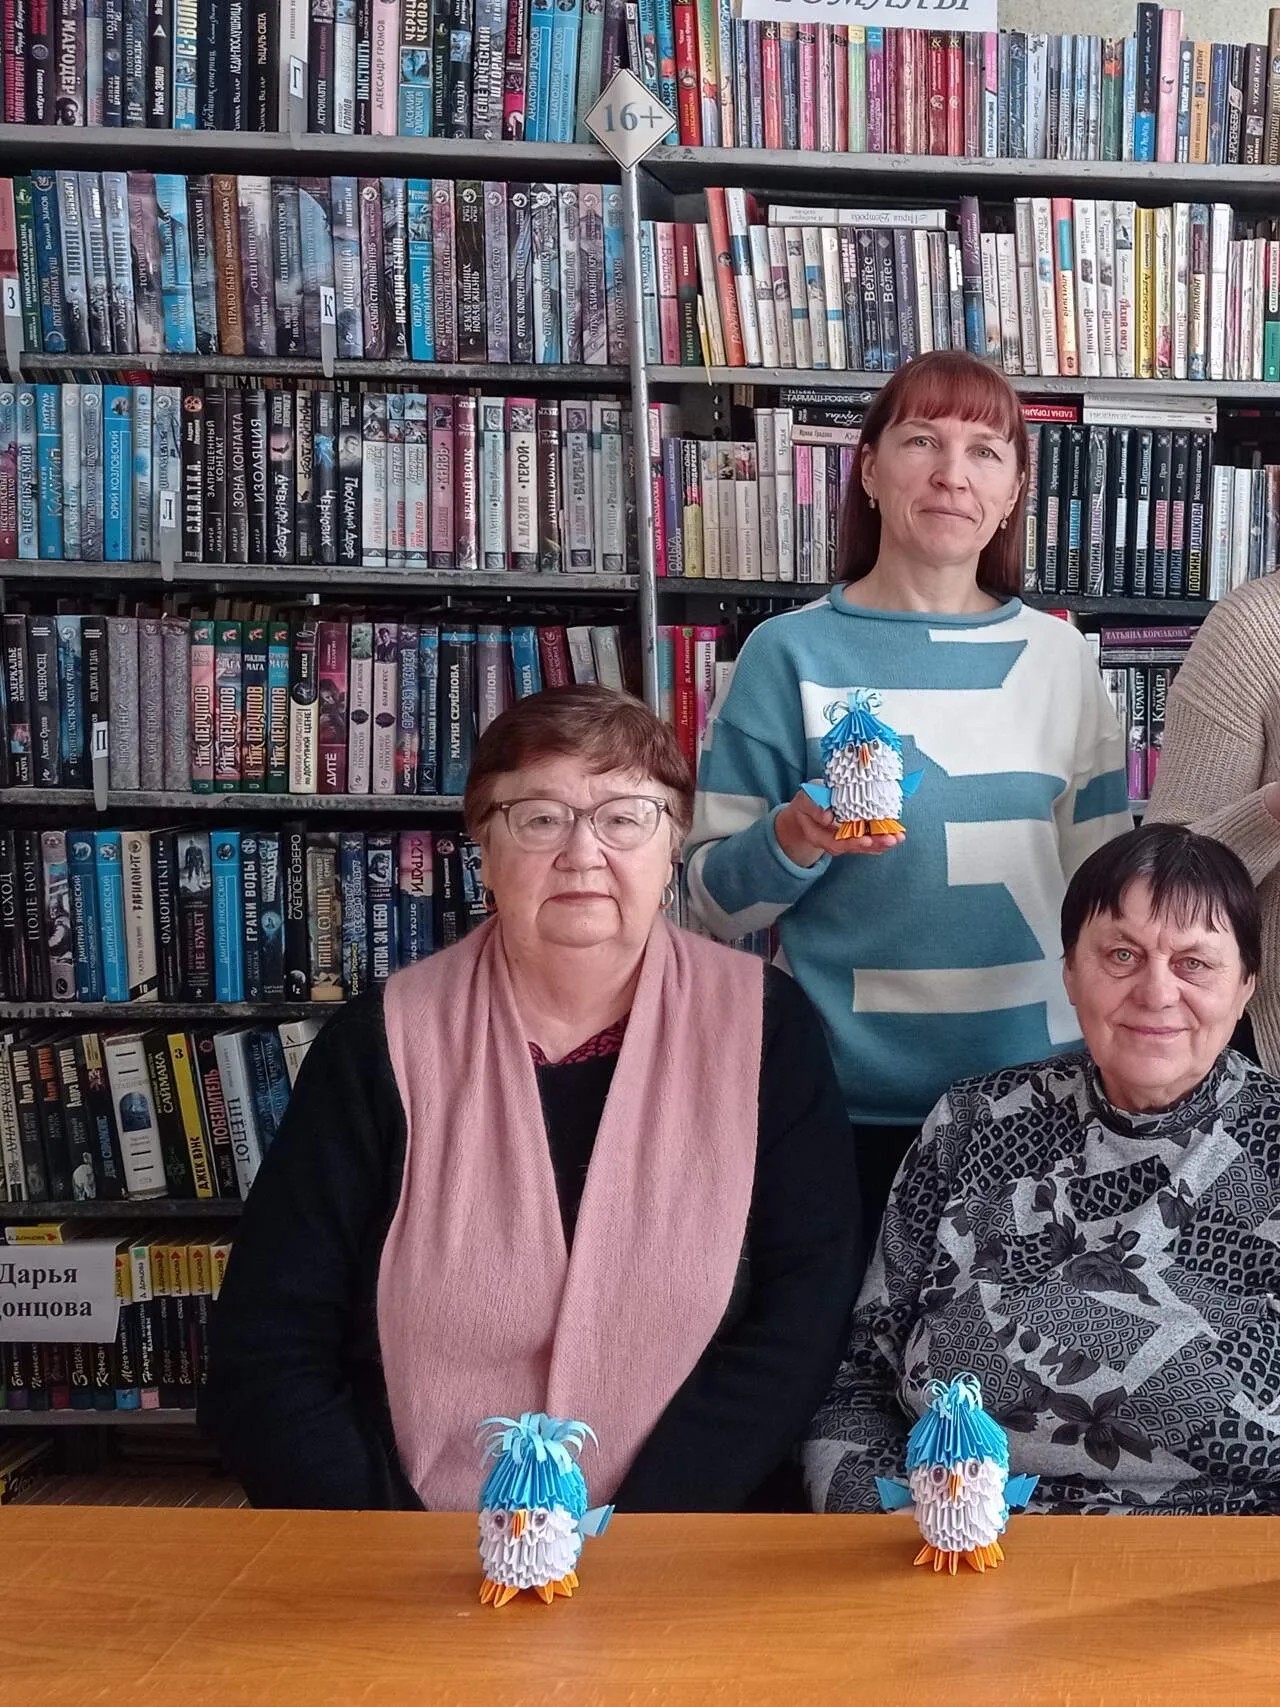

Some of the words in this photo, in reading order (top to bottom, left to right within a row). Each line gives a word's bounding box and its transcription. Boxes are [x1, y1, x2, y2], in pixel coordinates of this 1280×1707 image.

[230, 2, 242, 74] ЛЕДИ-ПОСЛУШНИЦА
[258, 13, 267, 34] СВЕТА
[377, 20, 385, 55] ГРОМОВ
[59, 19, 80, 94] МАРОДЁР
[258, 35, 268, 64] РЫЦАРЬ
[530, 27, 540, 70] ДРОЗДОВ
[553, 27, 563, 70] ДРОЗДОВ
[154, 67, 164, 90] земля
[357, 40, 369, 100] ВЫСТОЯТЬ
[376, 58, 385, 109] АЛЕКСАНДР
[477, 26, 491, 119] ГЕНЕТИЧЕСКИЙ
[492, 51, 503, 97] ШТОРМ
[153, 92, 164, 115] Ничья
[318, 80, 327, 125] АСТРОНАВТЫ
[454, 80, 467, 123] Колдун
[529, 72, 538, 120] АНАТОЛИЙ
[551, 72, 560, 120] АНАТОЛИЙ
[1252, 76, 1260, 105] ЧУЖОЙ
[343, 99, 352, 129] ГРОМОВ
[604, 101, 663, 133] 16+
[1230, 109, 1239, 154] АРСЕНЬЕВА
[49, 257, 58, 273] ДУШ
[392, 237, 404, 270] ТЕХНО
[226, 264, 234, 290] БЫТЬ
[863, 257, 875, 301] Велес
[883, 258, 894, 302] Велес
[51, 276, 62, 326] ПОТЕРЯННЫХ
[228, 294, 237, 324] ПРАВО
[394, 274, 407, 323] ИСЧАДИЯ
[412, 283, 422, 327] ОПЕРАТОР
[110, 430, 119, 490] КОЗЛОВСКИЙ
[207, 420, 215, 497] ЗАПРЕЩЕННЫЙ
[216, 437, 224, 481] КОНТАКТ
[232, 412, 244, 470] КОНТАКТА
[251, 418, 264, 502] ИЗОЛЯЦИЯ
[463, 448, 472, 479] ВОЛК
[518, 446, 530, 484] ГЕРОЙ
[21, 445, 32, 532] НЕСГИБАЕМЫЙ
[111, 492, 119, 519] ЮРИЙ
[233, 475, 244, 507] ЗОНА
[463, 481, 473, 520] БЕЛЫЙ
[518, 496, 530, 537] МАЗИН
[1070, 499, 1081, 547] ДАШКОВА
[1156, 500, 1168, 549] ДАШКОВА
[1191, 503, 1203, 550] ДАШКОВА
[668, 536, 676, 571] ОЛЬГА
[1045, 545, 1058, 585] ПОЛИНА
[1068, 548, 1080, 587] ПОЛИНА
[1189, 551, 1201, 591] ПОЛИНА
[1105, 631, 1141, 640] ТАТЬЯНА
[1143, 629, 1188, 639] КОРСАКОВА
[8, 647, 19, 702] ЗАЗЕРКАЛЬЕ
[37, 653, 49, 701] МЕЧЕНОСЕЦ
[449, 664, 460, 720] СЕМЁНОВА
[40, 716, 50, 738] Орлов
[451, 722, 460, 759] МАРИЯ
[41, 740, 49, 760] Алекс
[303, 736, 311, 776] ДОСТУПНОЙ
[325, 752, 337, 786] ДИТЁ
[290, 834, 302, 873] ОЗЕРО
[23, 861, 37, 892] БОЯ
[244, 860, 256, 897] ВОДЫ
[0, 872, 15, 928] ИСХОД
[73, 875, 84, 923] ЯНКОВСКИЙ
[158, 860, 171, 944] ФАВОРИТКИ
[292, 875, 303, 920] СЛЕПОЕ
[373, 904, 388, 928] НЕБО
[26, 896, 40, 940] ПОЛЕ
[246, 903, 257, 942] ГРАНИ
[373, 930, 387, 943] ЗА
[77, 925, 87, 963] ДМИТРИЙ
[374, 947, 388, 978] БИТВА
[13, 1050, 31, 1082] НОРТОН
[59, 1048, 78, 1084] НОРТОН
[154, 1051, 174, 1113] САЙМАКА
[66, 1084, 82, 1108] Андрэ
[204, 1069, 230, 1145] ПОБЕДИТЕЛЬ
[190, 1136, 204, 1160] ВЭНС
[227, 1097, 251, 1164] ШЁПОТ
[194, 1162, 209, 1190] ДЖЕК
[0, 1263, 78, 1289] Дарья
[0, 1301, 92, 1319] онцова
